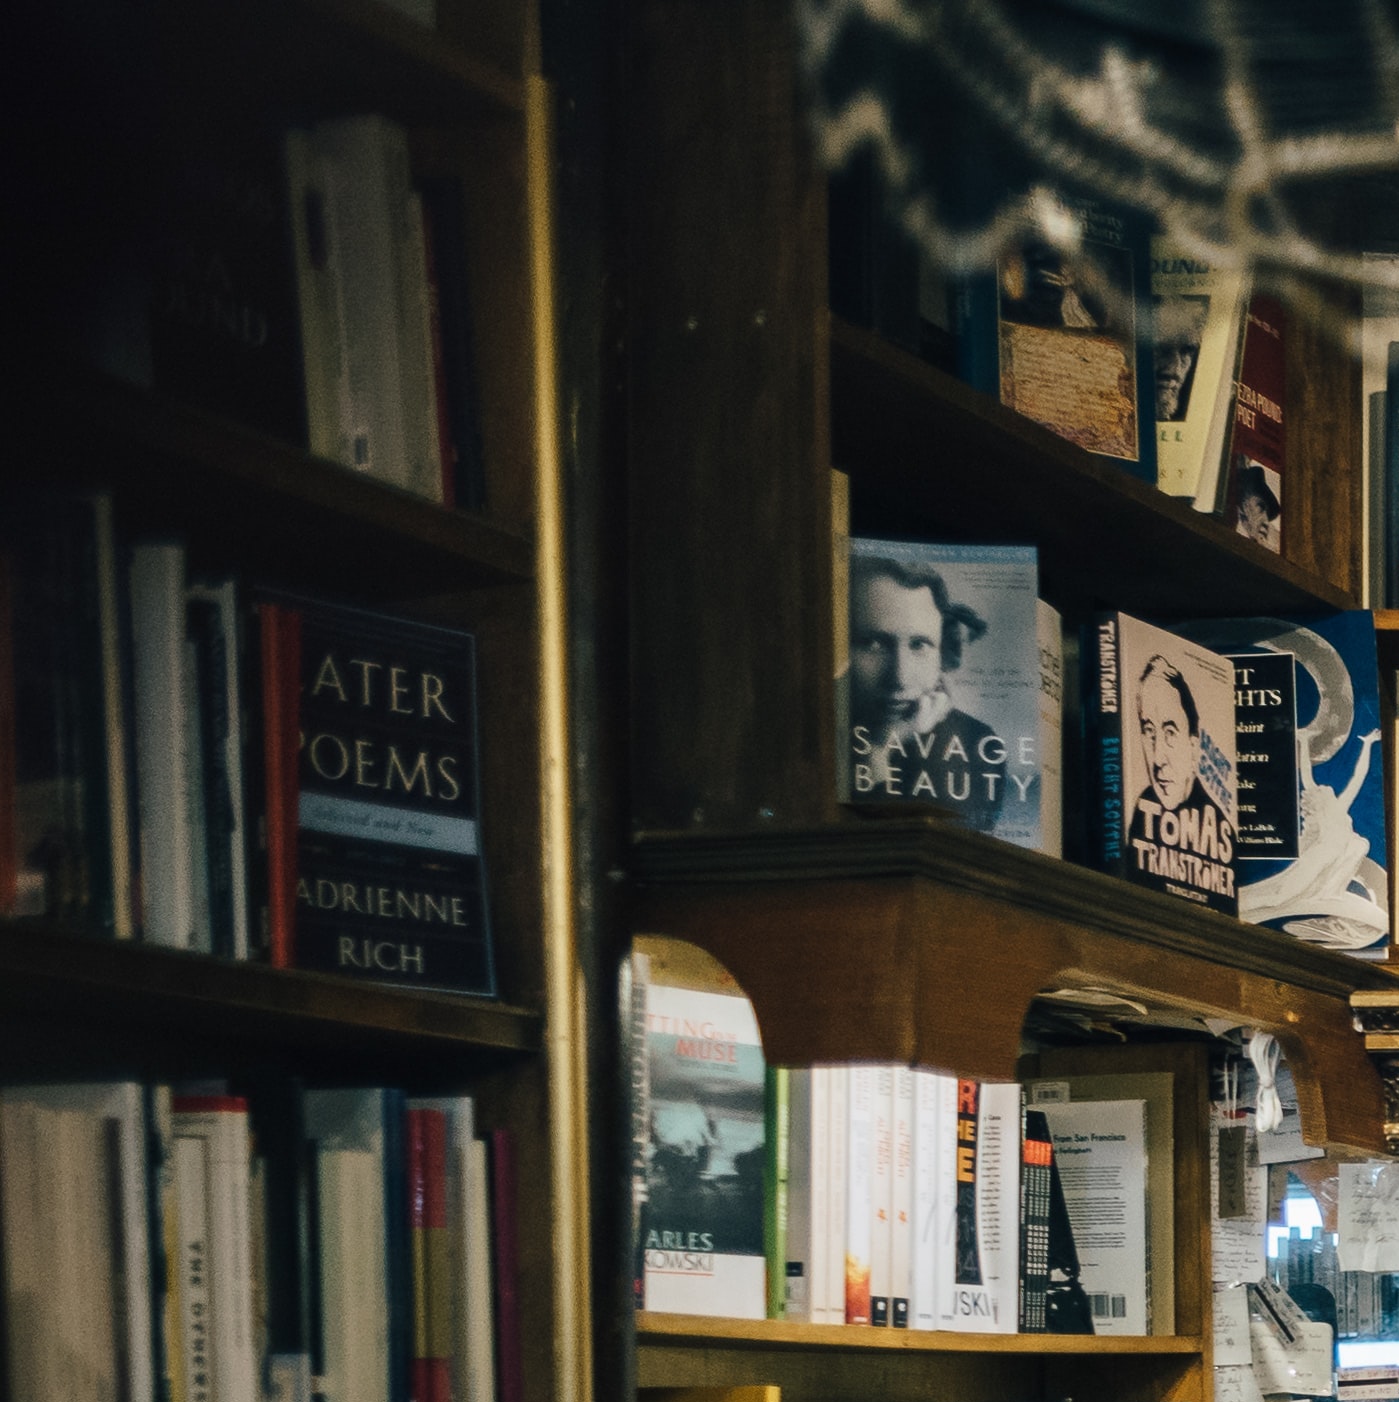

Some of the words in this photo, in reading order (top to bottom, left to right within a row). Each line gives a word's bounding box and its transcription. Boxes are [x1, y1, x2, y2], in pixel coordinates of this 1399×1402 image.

[300, 655, 455, 724] ATER
[853, 725, 1036, 765] SAVAGE
[855, 764, 1035, 801] BEAUTY
[1138, 798, 1233, 865] TOMAS
[297, 878, 469, 927] ADRIENNE
[338, 936, 425, 974] RICH
[675, 1039, 737, 1063] MUSE
